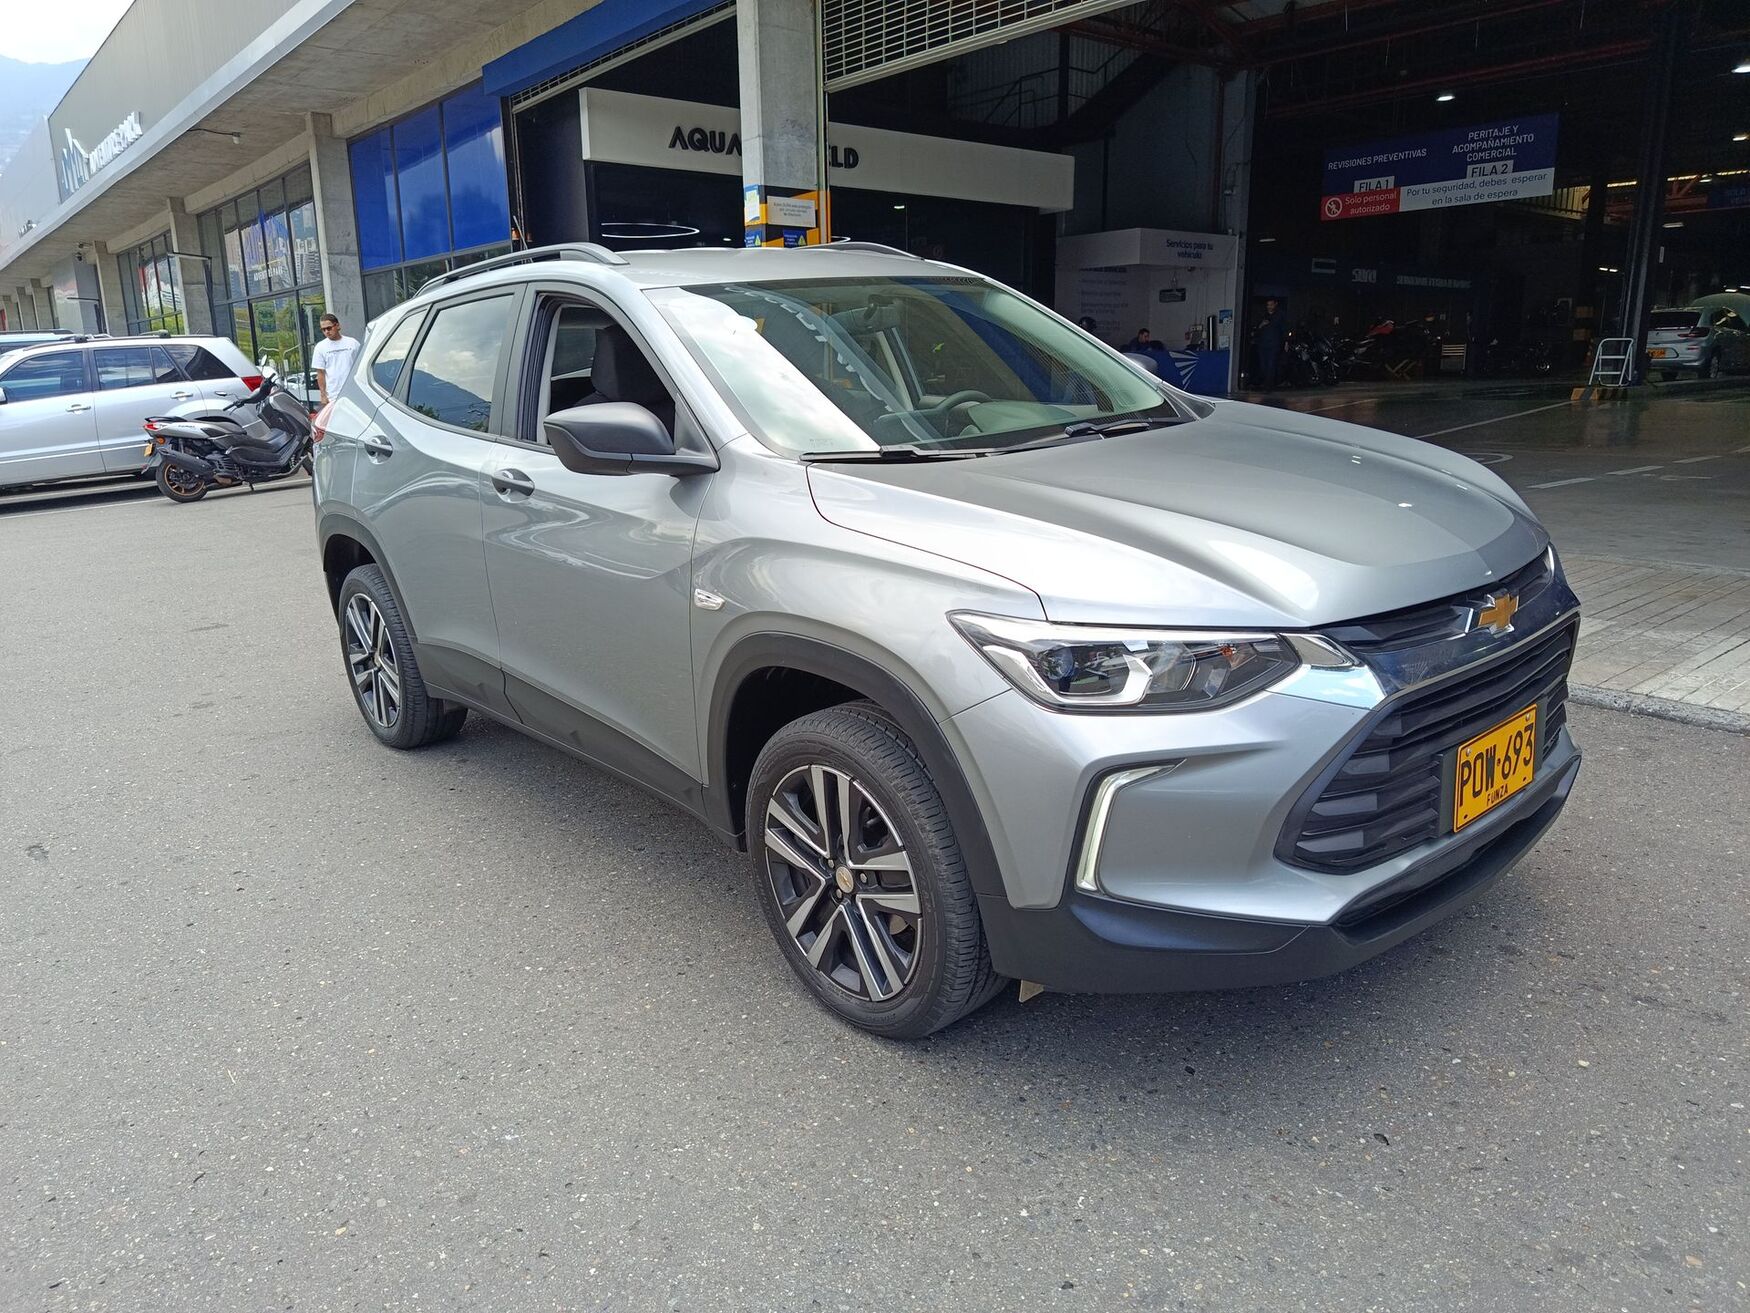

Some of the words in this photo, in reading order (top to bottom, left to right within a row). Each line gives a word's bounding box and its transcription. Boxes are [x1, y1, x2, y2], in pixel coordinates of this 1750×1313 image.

[1468, 125, 1511, 141] PERITAJE
[1512, 124, 1519, 134] Y
[1452, 133, 1535, 154] ACOMPAÑAMIENTO
[1328, 156, 1372, 171] REVISIONES
[1372, 148, 1427, 164] PREVENTIVAS
[1466, 147, 1518, 162] COMERCIAL
[1471, 164, 1498, 178] FILA
[1501, 163, 1508, 174] 2
[1359, 180, 1382, 192] FILA
[1384, 179, 1389, 190] 1
[1406, 188, 1420, 197] Por
[1422, 186, 1430, 195] tu
[1432, 180, 1477, 195] seguridad,
[1479, 177, 1507, 188] debes
[1511, 173, 1548, 185] esperar
[1345, 195, 1361, 205] Solo
[1363, 191, 1397, 204] personal
[1431, 197, 1443, 205] en
[1444, 195, 1452, 204] la
[1454, 194, 1471, 203] sala
[1473, 192, 1484, 201] de
[1487, 190, 1518, 201] espera
[1350, 202, 1391, 215] autorizado
[1166, 239, 1193, 249] Servicios
[1487, 784, 1508, 806] FUNZA
